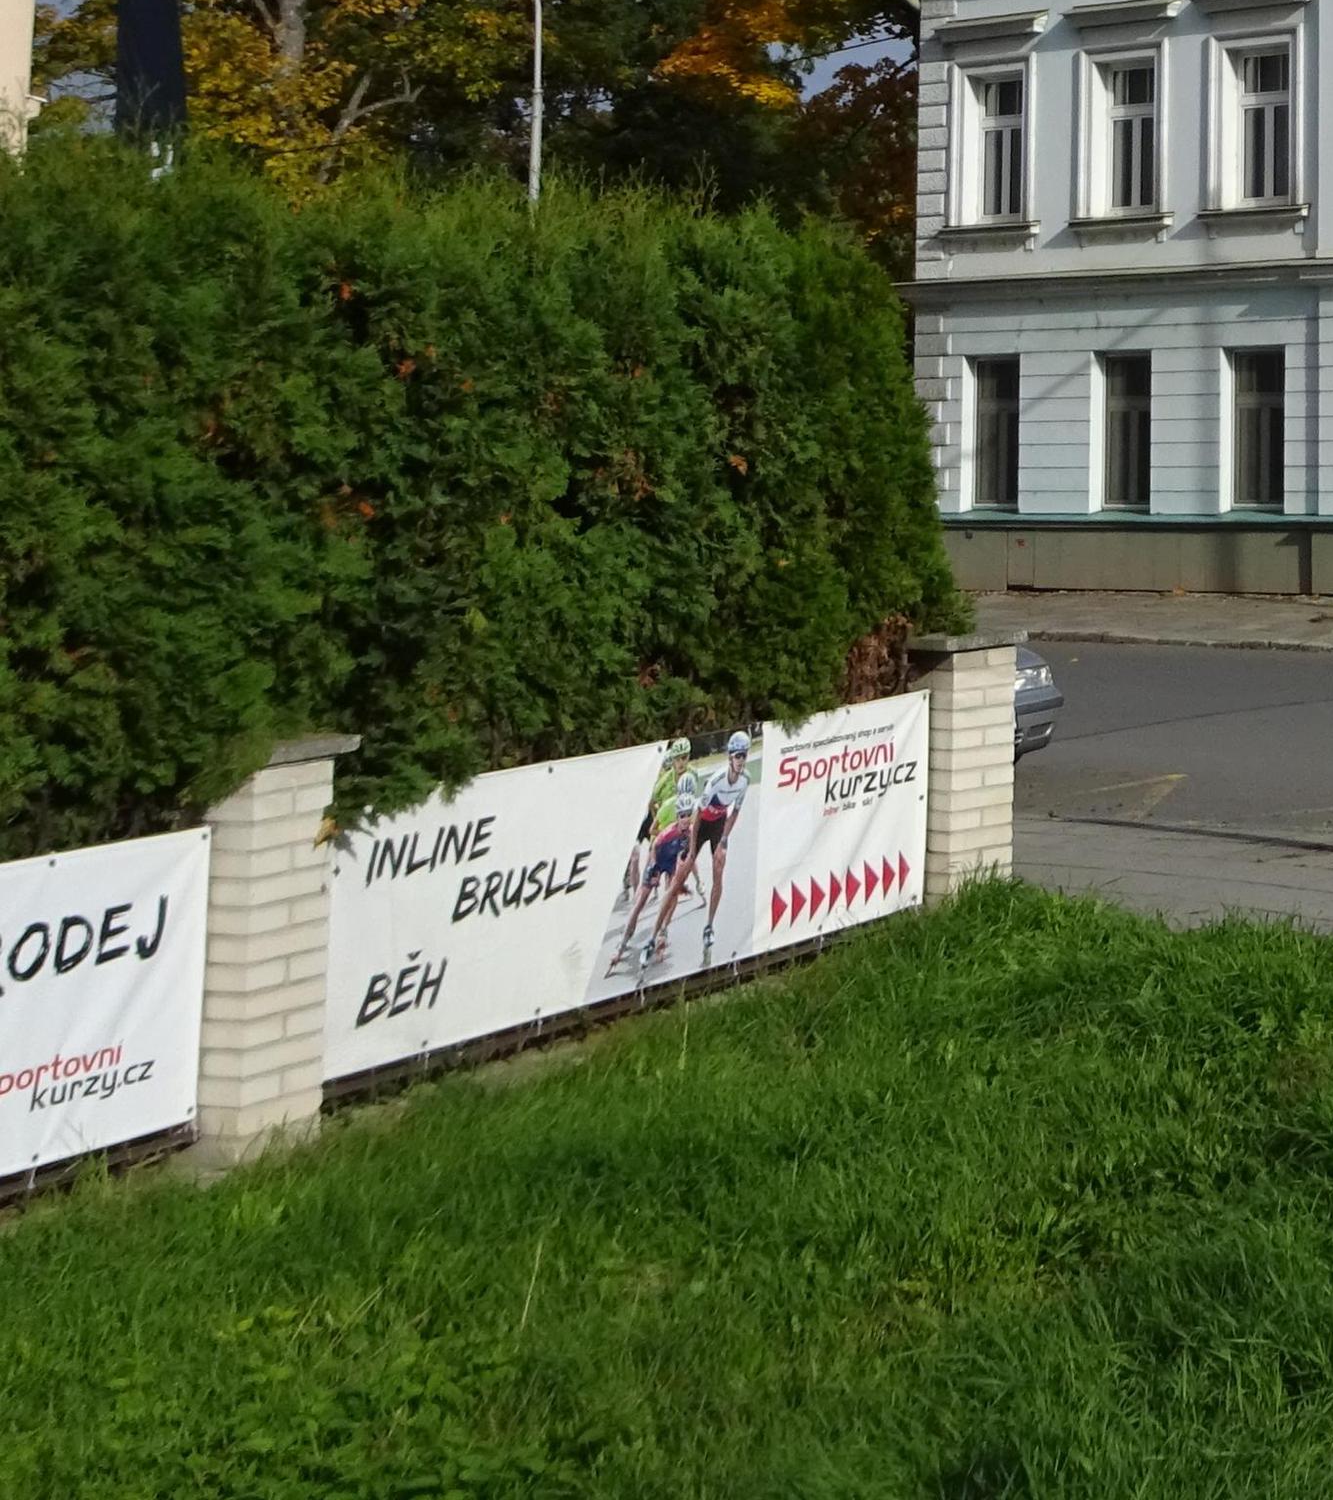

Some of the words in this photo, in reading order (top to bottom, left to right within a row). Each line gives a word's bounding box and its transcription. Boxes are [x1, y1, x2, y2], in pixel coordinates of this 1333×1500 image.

[777, 736, 896, 792] Sportovní
[825, 761, 918, 804] kurzy.cz
[366, 815, 496, 888] INLINE
[452, 850, 592, 924] BRUSLE
[0, 894, 169, 997] ODEJ
[355, 950, 448, 1029] BĚH
[29, 1060, 155, 1113] kurzy.cz
